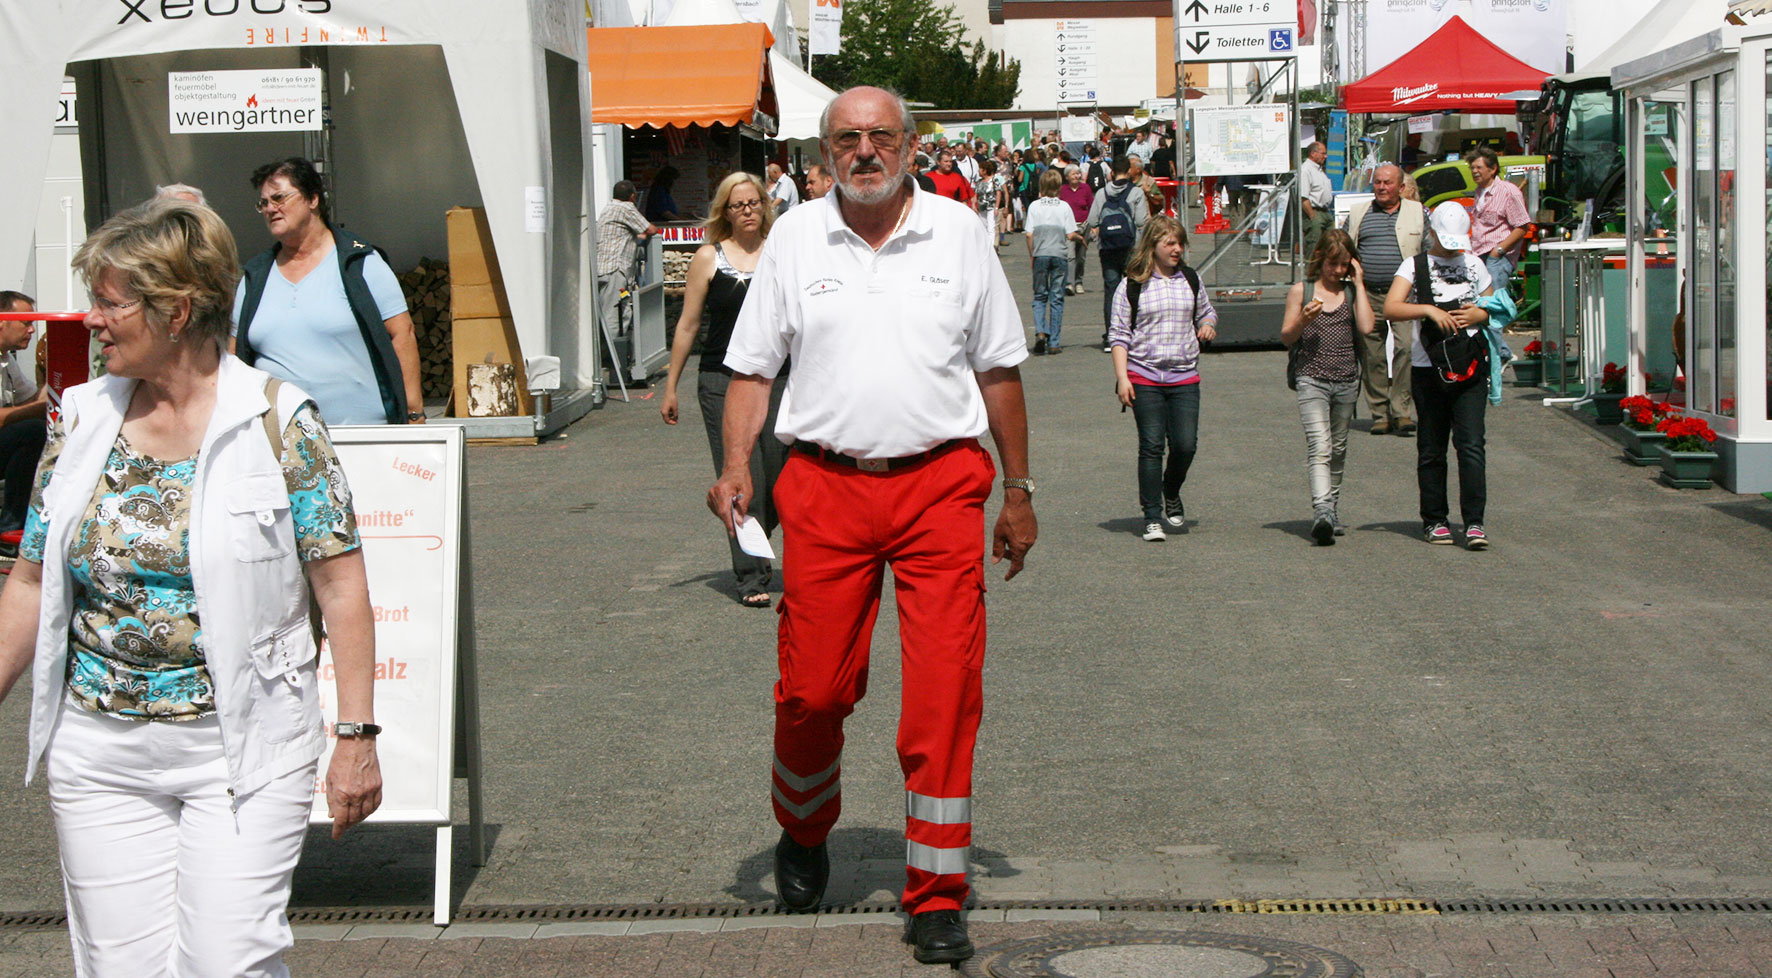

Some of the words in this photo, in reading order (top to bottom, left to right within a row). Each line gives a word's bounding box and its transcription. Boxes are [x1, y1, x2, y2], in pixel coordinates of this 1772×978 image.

[1214, 4, 1243, 14] Halle
[1248, 4, 1253, 13] 1
[1262, 3, 1270, 12] 6
[1216, 37, 1265, 48] Toiletten
[174, 74, 214, 82] kaminöfen
[261, 76, 280, 84] 06181
[285, 77, 294, 85] 90
[174, 83, 217, 91] feuermöbel
[174, 92, 237, 101] objektgestaltung
[1390, 83, 1439, 102] Milwaukee
[392, 456, 437, 482] Lecker
